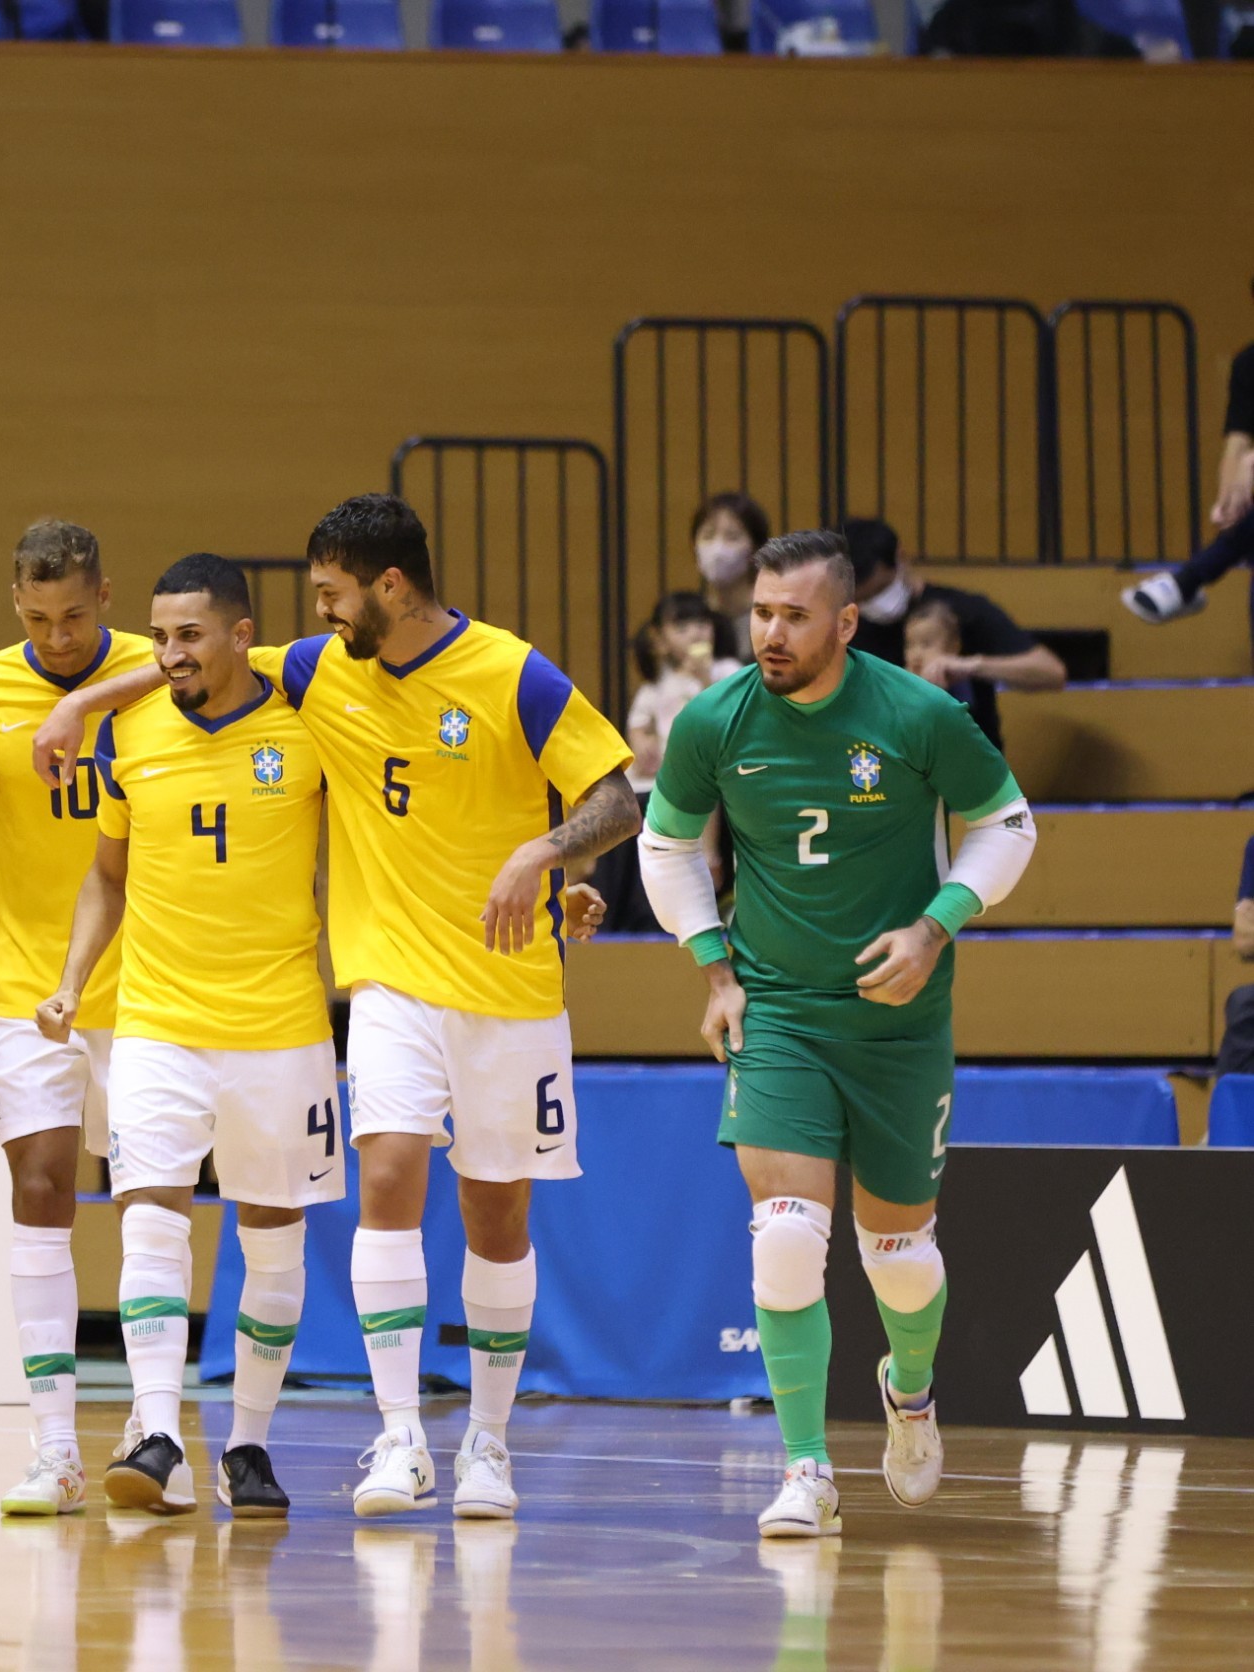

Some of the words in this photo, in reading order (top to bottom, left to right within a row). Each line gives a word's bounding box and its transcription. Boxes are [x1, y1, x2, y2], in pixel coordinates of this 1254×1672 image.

[436, 750, 470, 761] FUTSAL
[49, 757, 100, 819] 10
[251, 787, 286, 795] FUTSAL
[383, 757, 411, 817] 6
[850, 794, 886, 803] FUTSAL
[191, 803, 227, 863] 4
[798, 809, 829, 865] 2
[307, 1098, 335, 1158] 4
[536, 1073, 565, 1136] 6
[932, 1093, 952, 1159] 2
